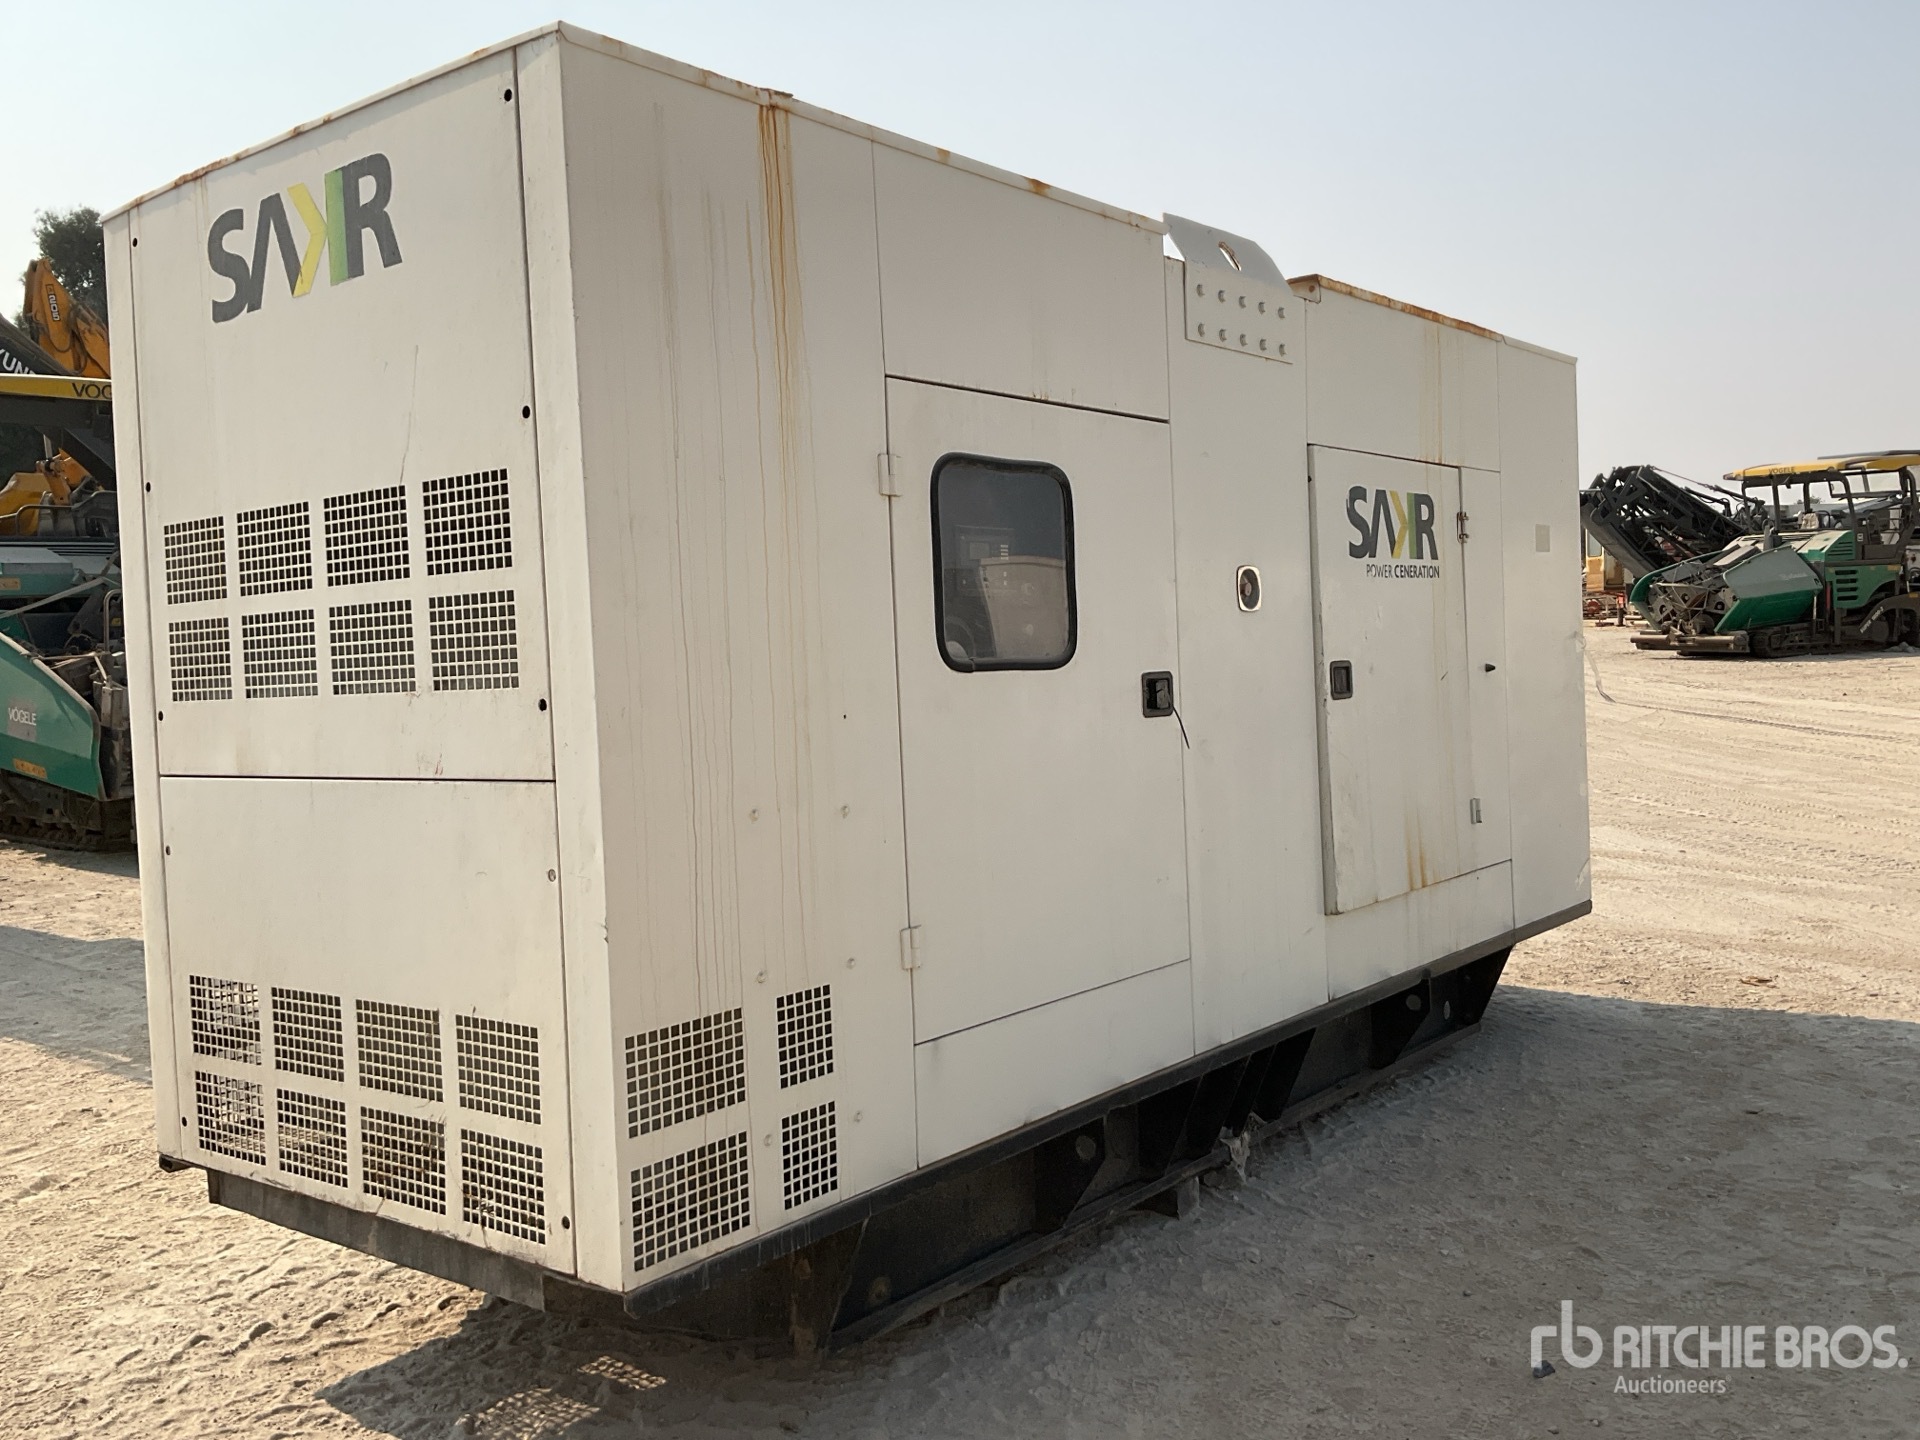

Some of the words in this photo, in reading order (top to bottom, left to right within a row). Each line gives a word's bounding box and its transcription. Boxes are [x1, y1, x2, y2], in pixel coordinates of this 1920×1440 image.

[207, 153, 403, 324] SAKR
[1346, 485, 1439, 560] SAKR
[1366, 563, 1394, 579] POWER
